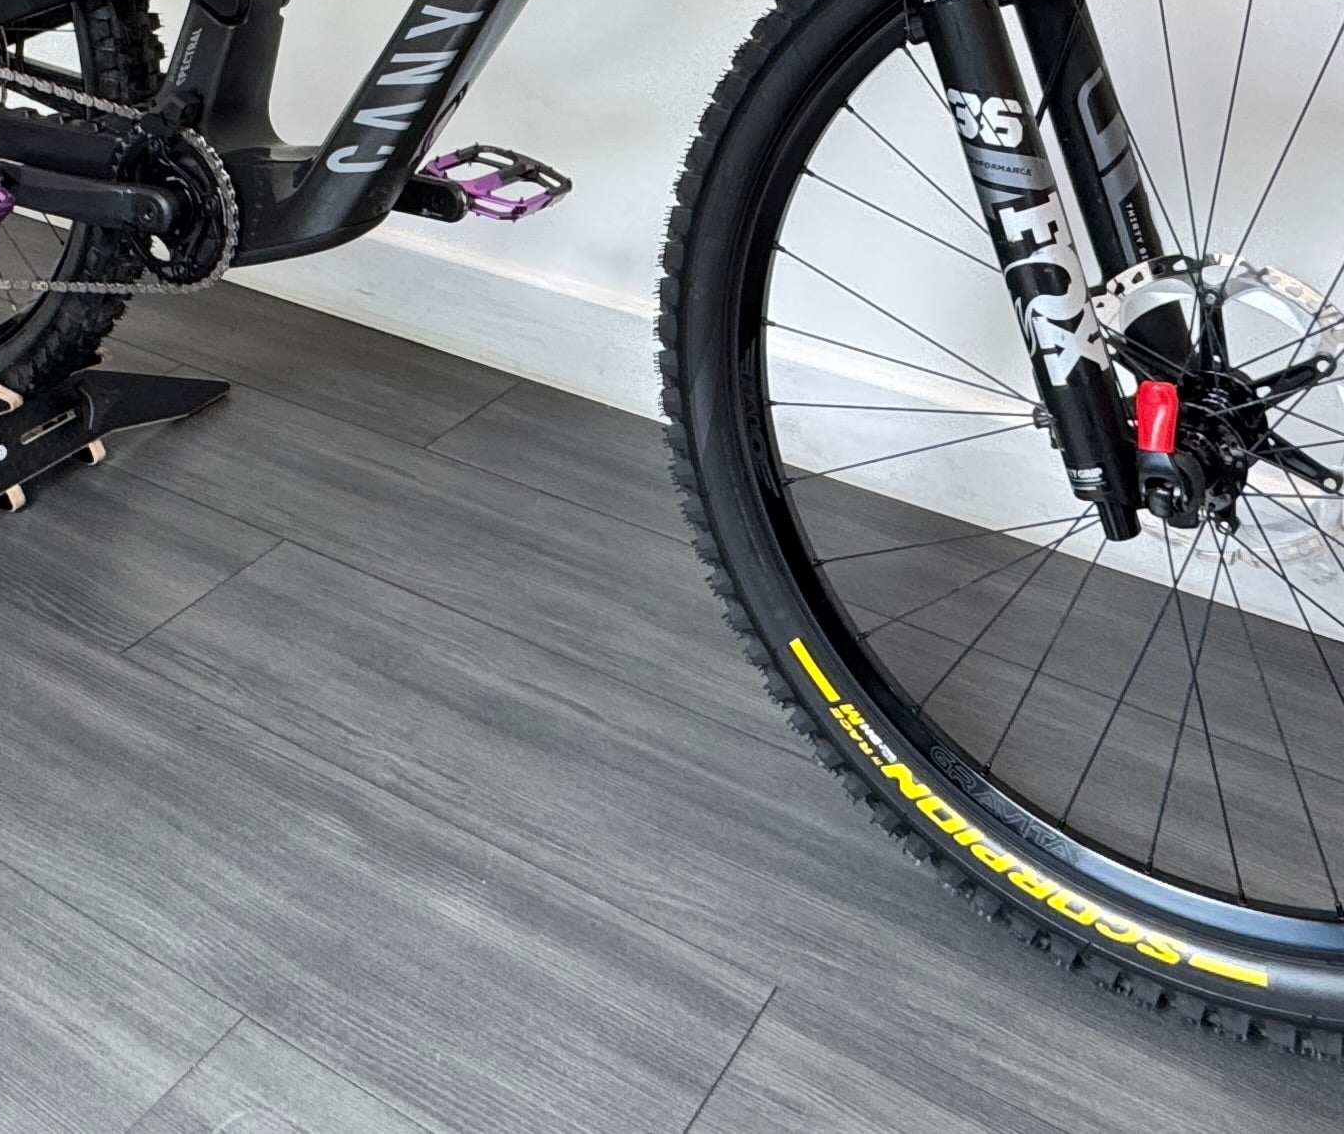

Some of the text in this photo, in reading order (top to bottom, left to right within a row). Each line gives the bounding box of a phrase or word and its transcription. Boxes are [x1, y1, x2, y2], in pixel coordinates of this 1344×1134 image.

[176, 27, 203, 86] SPECTRAL
[947, 88, 1024, 148] 36
[1126, 202, 1149, 261] THIRTY SI
[998, 191, 1110, 386] FOX
[829, 707, 873, 755] RACE
[930, 745, 1088, 866] GRAVITA
[881, 763, 1188, 965] SCORPION
